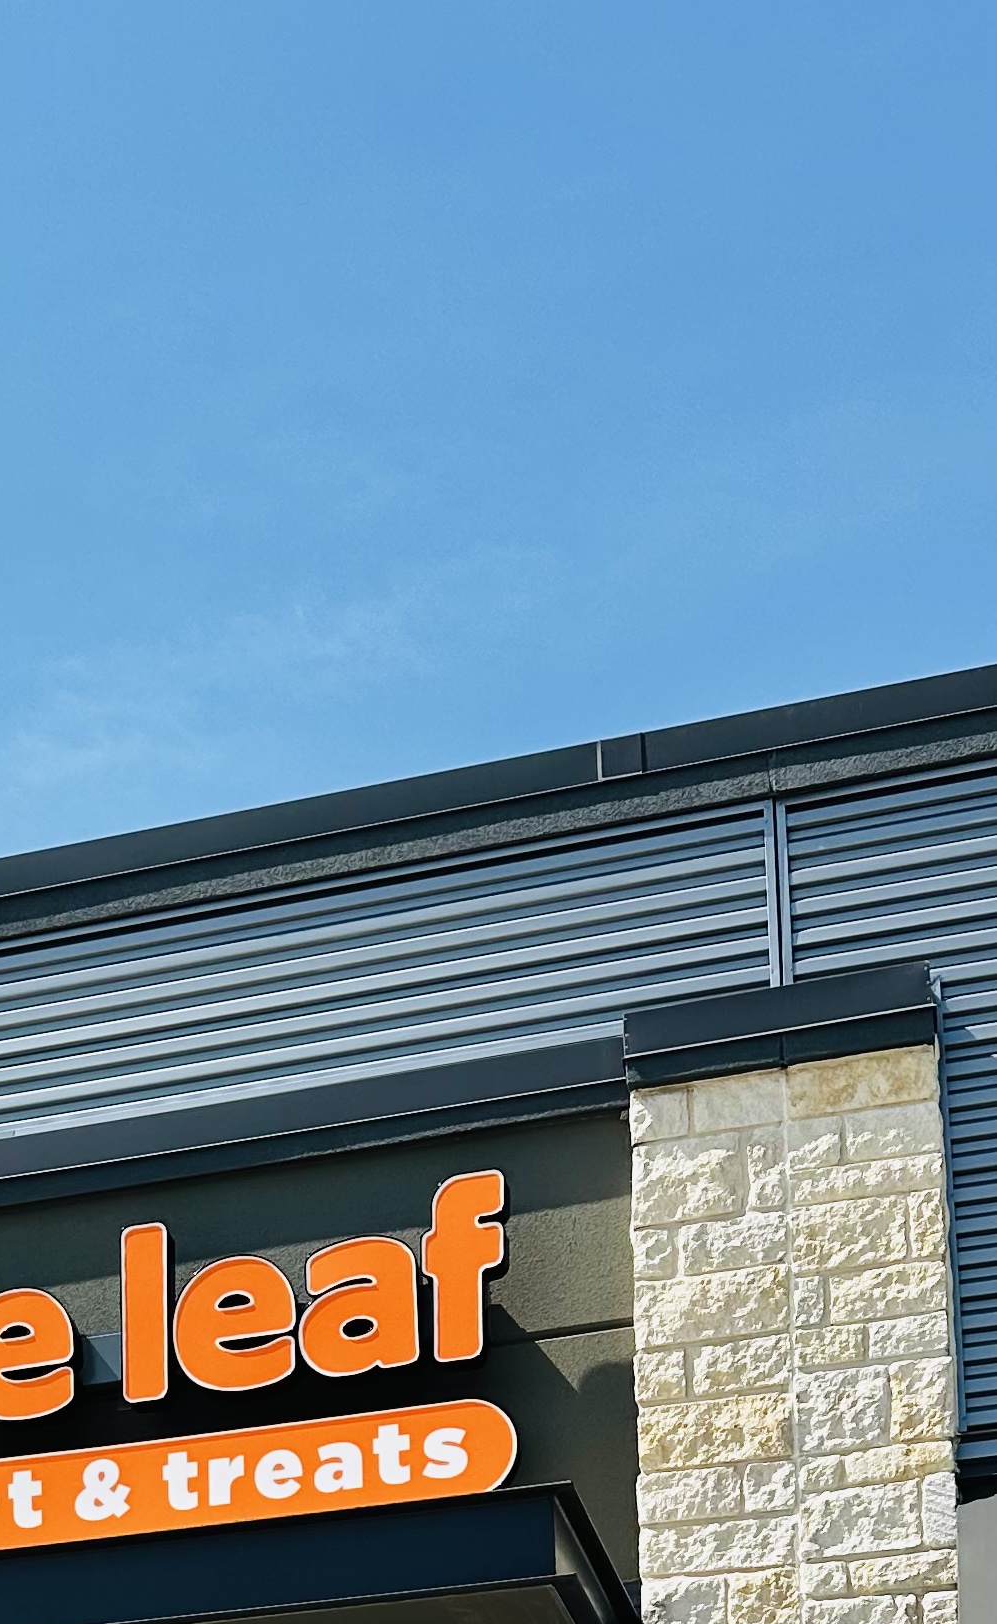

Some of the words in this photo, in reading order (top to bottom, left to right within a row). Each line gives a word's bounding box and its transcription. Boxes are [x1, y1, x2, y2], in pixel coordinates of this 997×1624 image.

[120, 1168, 505, 1403] leaf
[74, 1458, 131, 1523] &
[161, 1423, 470, 1511] treats
